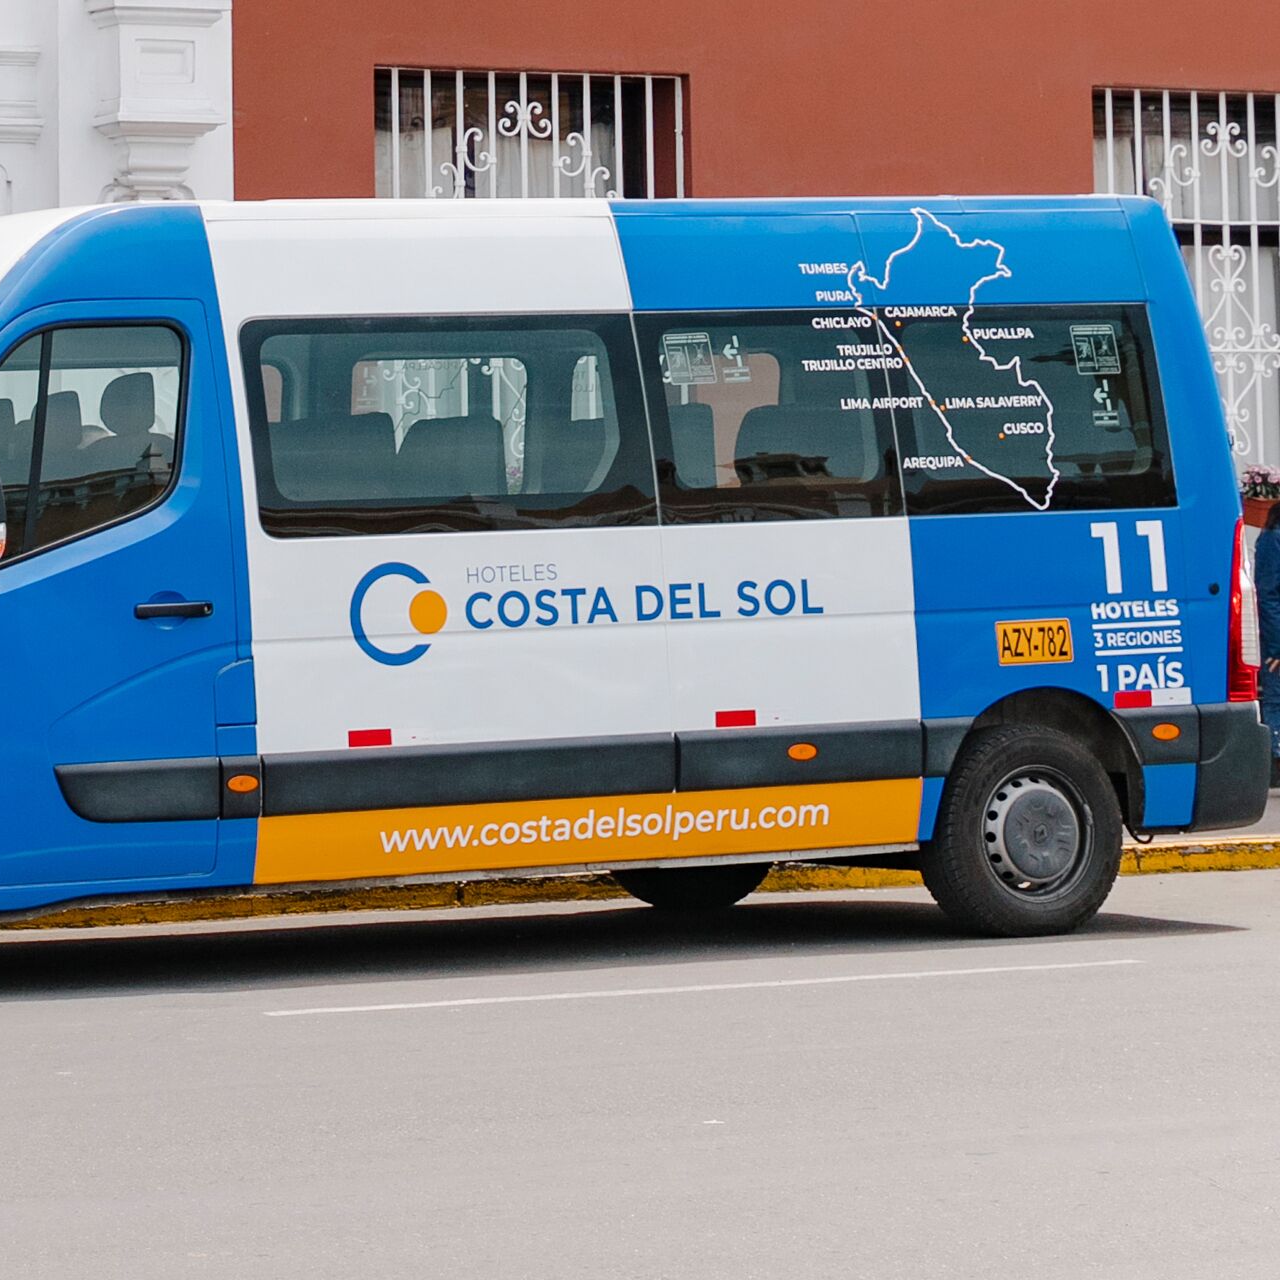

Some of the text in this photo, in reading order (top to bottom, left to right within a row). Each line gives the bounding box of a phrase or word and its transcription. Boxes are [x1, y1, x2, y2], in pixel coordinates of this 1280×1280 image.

[798, 263, 849, 275] TUMBES
[815, 290, 853, 302] PIURA
[884, 306, 957, 317] CAJAMARCA
[811, 317, 871, 329] CHICLAYO
[973, 327, 1034, 340] PUCALLPA
[836, 344, 892, 356] TRUJILLO
[802, 357, 903, 371] TRUJILLO CENTRO
[840, 396, 923, 410] LIMA AIRPORT
[945, 395, 1043, 409] LIMA SALAVERRY
[1003, 422, 1044, 434] CUSCO
[903, 455, 964, 469] AREQUIPA
[1090, 519, 1168, 594] 11
[466, 563, 557, 584] HOTELES
[465, 578, 824, 630] COSTA DEL SOL
[1091, 599, 1179, 620] HOTELES
[1001, 625, 1069, 658] AZY-782
[1093, 629, 1182, 648] 3 REGIONES
[1096, 656, 1185, 692] 1 PAÍS
[379, 803, 830, 853] www.costadelsolperu.com
